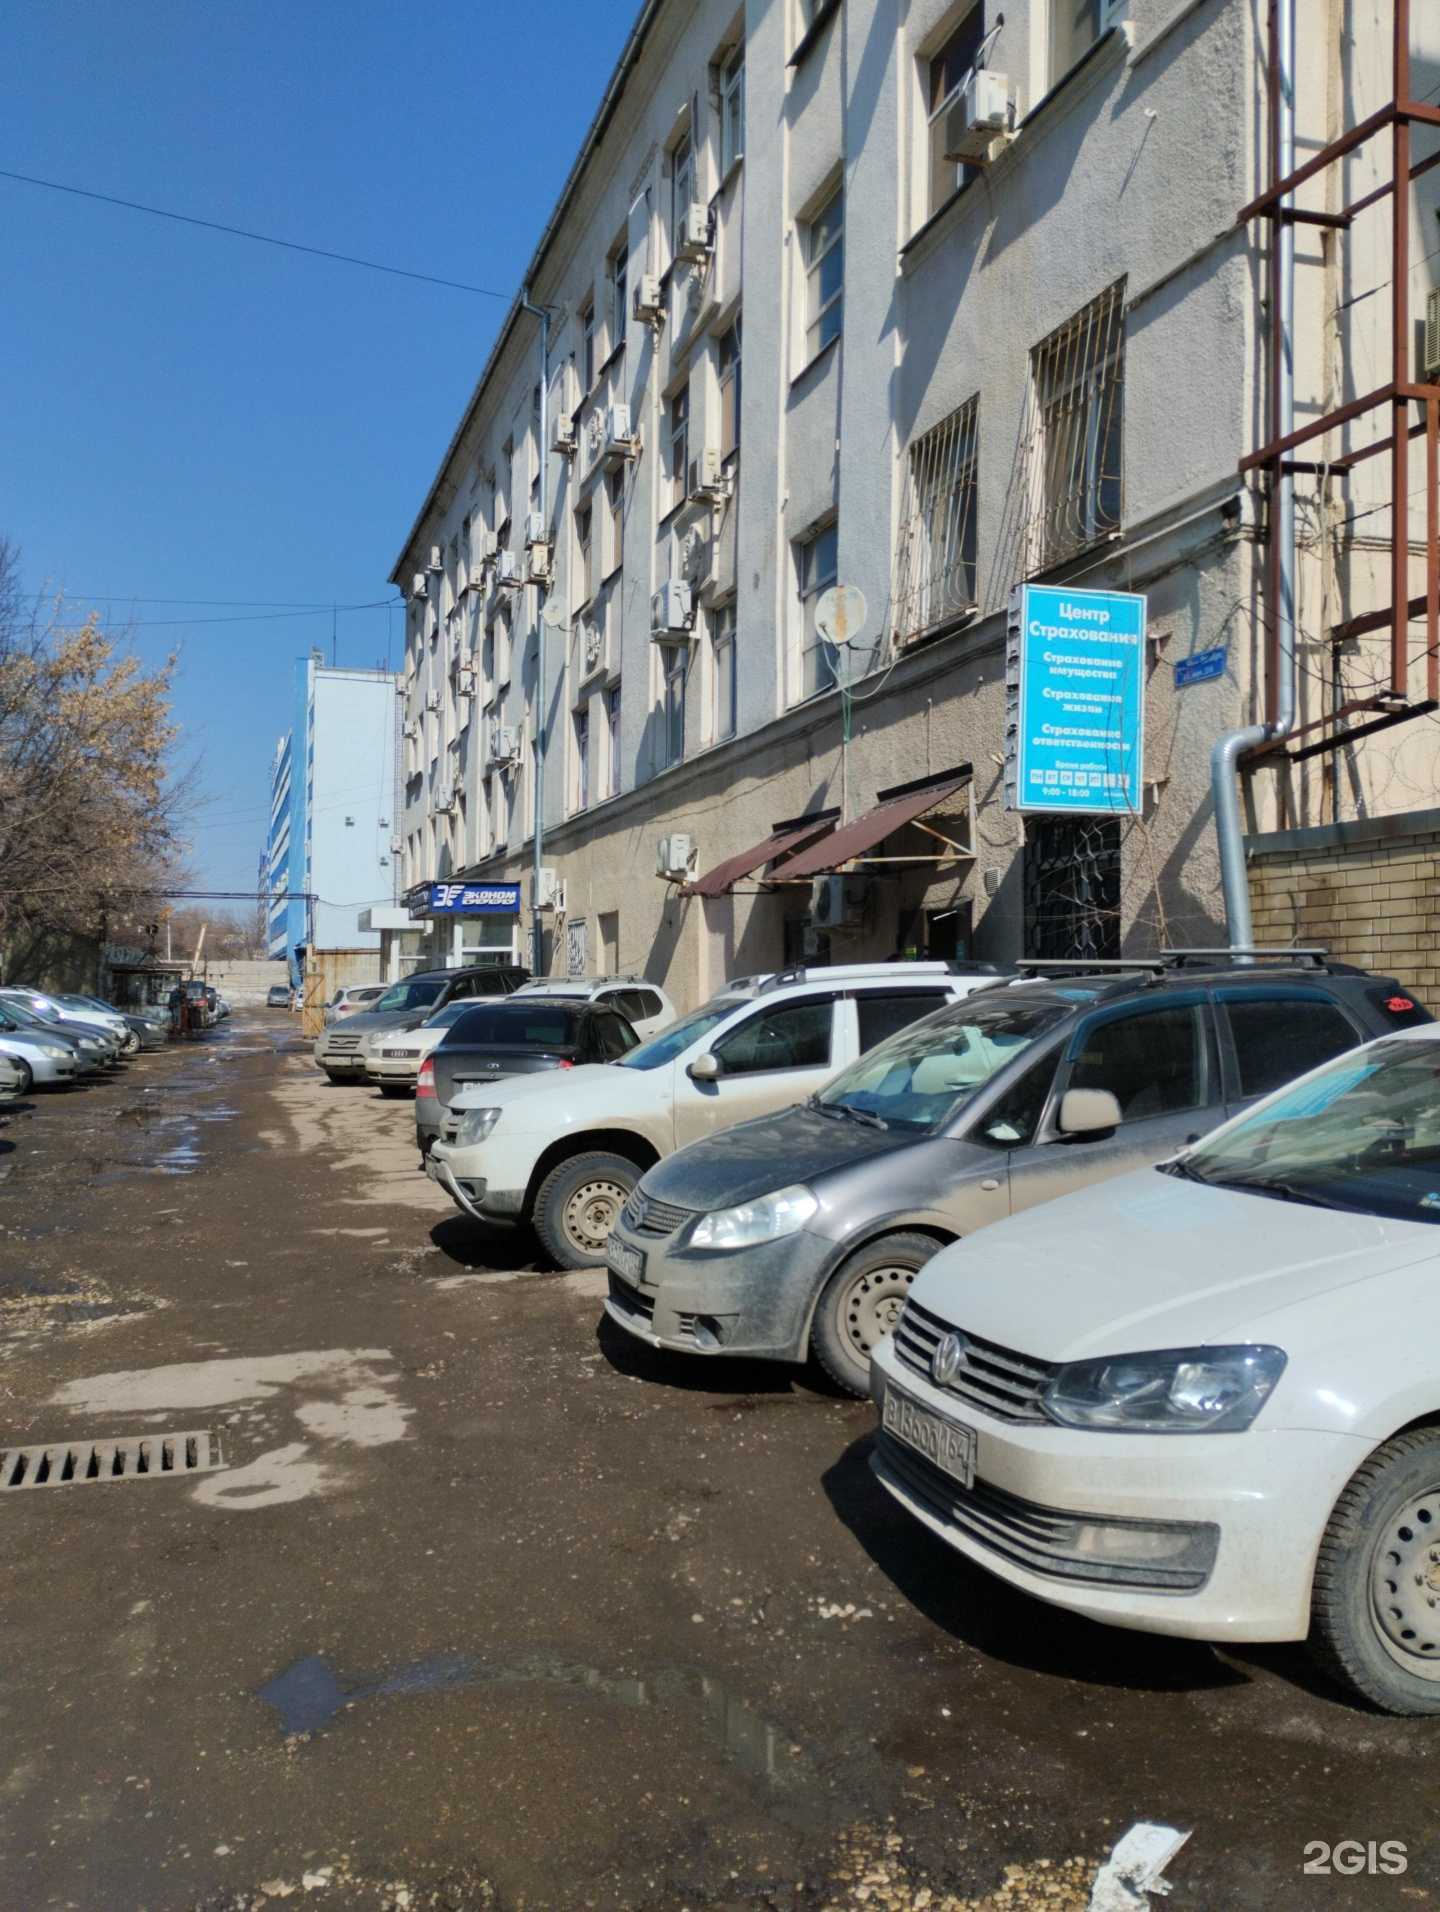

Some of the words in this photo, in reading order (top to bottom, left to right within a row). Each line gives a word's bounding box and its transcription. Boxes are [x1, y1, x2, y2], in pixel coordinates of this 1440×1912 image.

[1059, 602, 1110, 625] Центр
[1029, 621, 1138, 645] Страхования
[1043, 651, 1123, 668] Страхование
[462, 891, 517, 905] ЭКОНОМ
